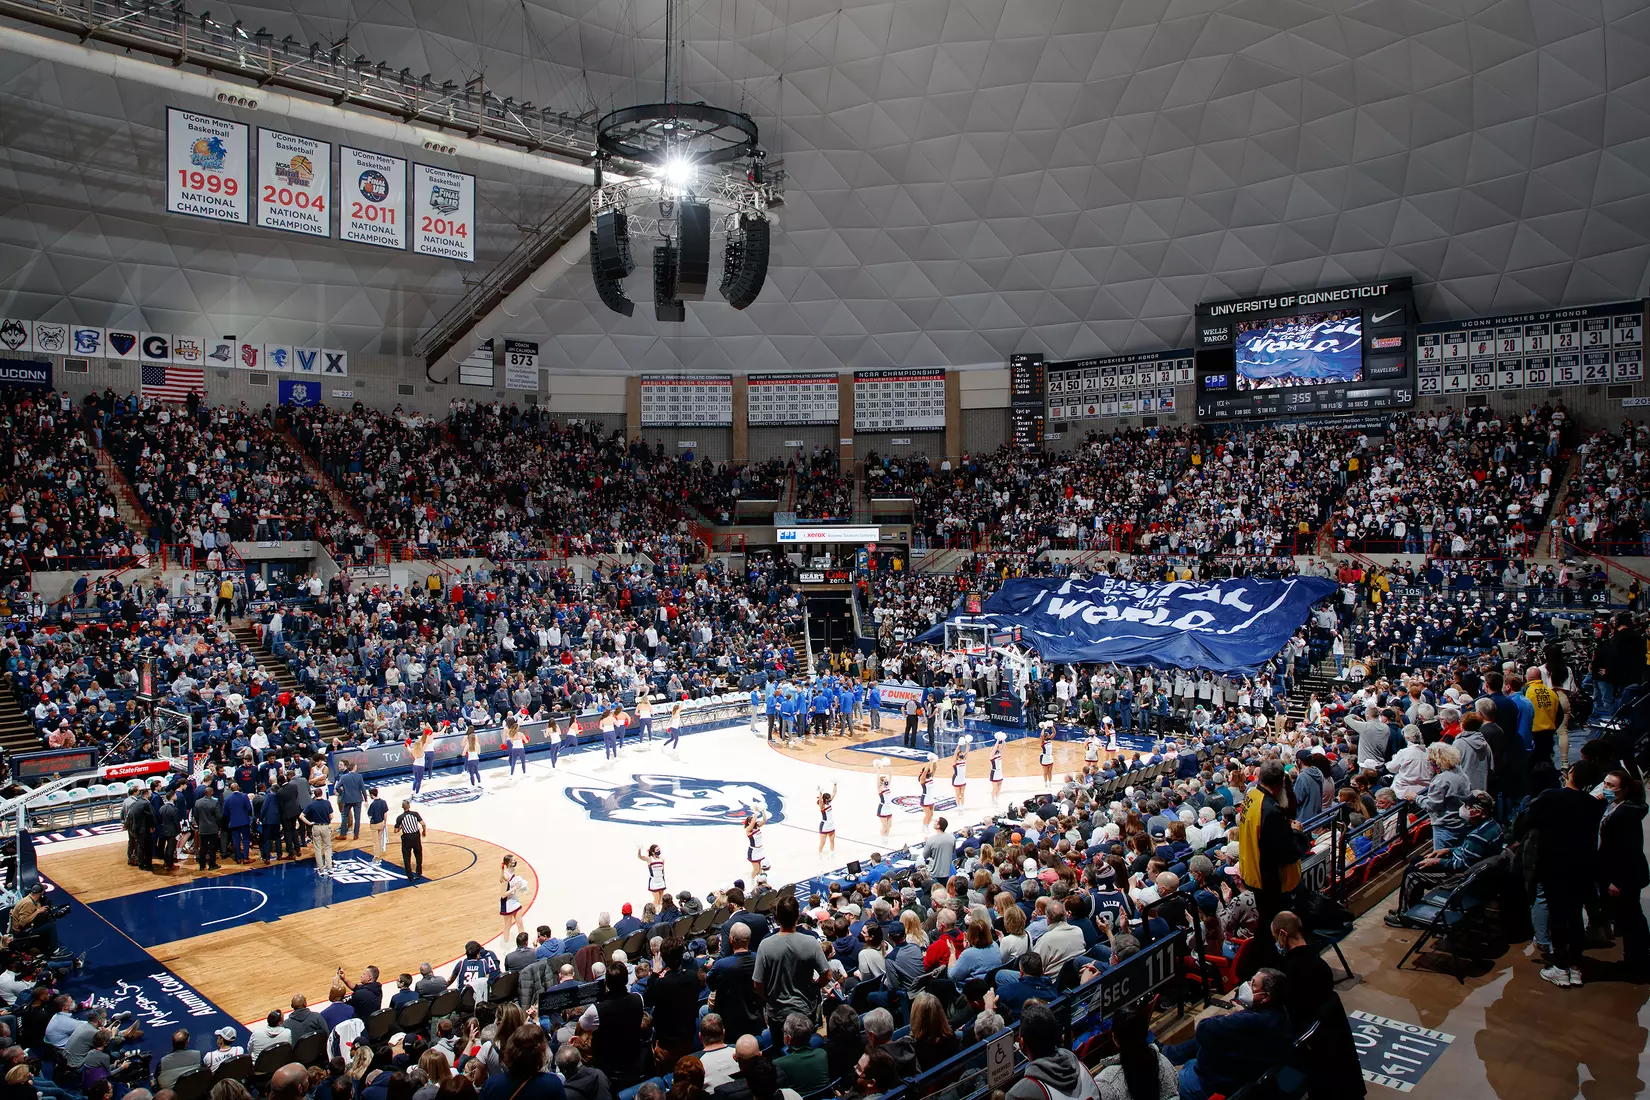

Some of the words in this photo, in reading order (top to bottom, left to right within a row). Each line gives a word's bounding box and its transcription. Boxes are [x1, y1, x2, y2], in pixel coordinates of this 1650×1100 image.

[183, 113, 210, 125] UConn
[212, 119, 235, 130] Men's
[188, 123, 230, 138] Basketball
[271, 132, 297, 143] UConn
[298, 138, 319, 148] Men's
[276, 142, 314, 156] Basketball
[352, 150, 375, 161] UConn
[376, 155, 395, 165] Men's
[356, 160, 391, 172] Basketball
[425, 167, 446, 177] UConn
[447, 172, 465, 181] Men's
[178, 169, 238, 196] 1999
[367, 175, 386, 186] FINAL
[428, 176, 461, 188] Basketball
[263, 185, 325, 212] 2004
[439, 188, 460, 199] FINAL
[182, 192, 236, 208] NATIONAL
[177, 202, 240, 220] CHAMPIONS
[270, 207, 319, 222] NATIONAL
[351, 201, 395, 225] 2011
[265, 217, 323, 233] CHAMPIONS
[351, 221, 396, 236] NATIONAL
[421, 215, 467, 239] 2014
[347, 231, 399, 246] CHAMPIONS
[423, 235, 465, 249] NATIONAL
[420, 244, 468, 259] CHAMPIONS
[1211, 299, 1276, 316] UNIVERSITY
[1280, 296, 1295, 308] OF
[1299, 284, 1389, 305] CONNECTICUT
[1461, 320, 1491, 328] UCONN
[1496, 315, 1535, 323] HUSKIES
[1555, 310, 1588, 318] HONOR
[1203, 327, 1228, 336] WELLS
[1589, 331, 1602, 344] 31
[1620, 328, 1634, 341] 14
[1203, 334, 1228, 343] FARGO
[1532, 337, 1542, 349] 31
[1560, 334, 1572, 346] 23
[142, 336, 170, 359] G
[1452, 345, 1458, 356] 3
[1504, 339, 1515, 351] 20
[1424, 347, 1434, 358] 32
[325, 352, 344, 374] X
[511, 354, 533, 366] 873
[0, 368, 46, 380] UCONN
[882, 369, 940, 377] CHAMPIONSHIP
[1181, 369, 1189, 379] 10
[1560, 367, 1572, 380] 15
[1586, 365, 1607, 378] 24
[1618, 363, 1639, 376] 33
[1103, 377, 1115, 387] 52
[1121, 375, 1134, 385] 42
[1141, 373, 1151, 383] 25
[1161, 371, 1170, 381] 33
[1205, 375, 1226, 383] CBS
[1452, 376, 1459, 388] 4
[1475, 374, 1490, 386] 30
[1506, 372, 1514, 384] 3
[1050, 382, 1062, 391] 24
[1067, 380, 1079, 390] 50
[1086, 379, 1096, 388] 21
[1421, 378, 1437, 390] 23
[1292, 393, 1311, 403] 3:55
[825, 570, 849, 579] Coke
[1046, 597, 1216, 630] WORLD
[991, 713, 1019, 723] TRAVELERS
[382, 751, 401, 762] Try
[1103, 900, 1120, 908] ALLEN
[1103, 977, 1130, 1007] SEC
[1145, 943, 1175, 987] 111
[147, 971, 184, 992] Court
[167, 988, 217, 1017] Alumni
[1383, 1034, 1437, 1065] 111
